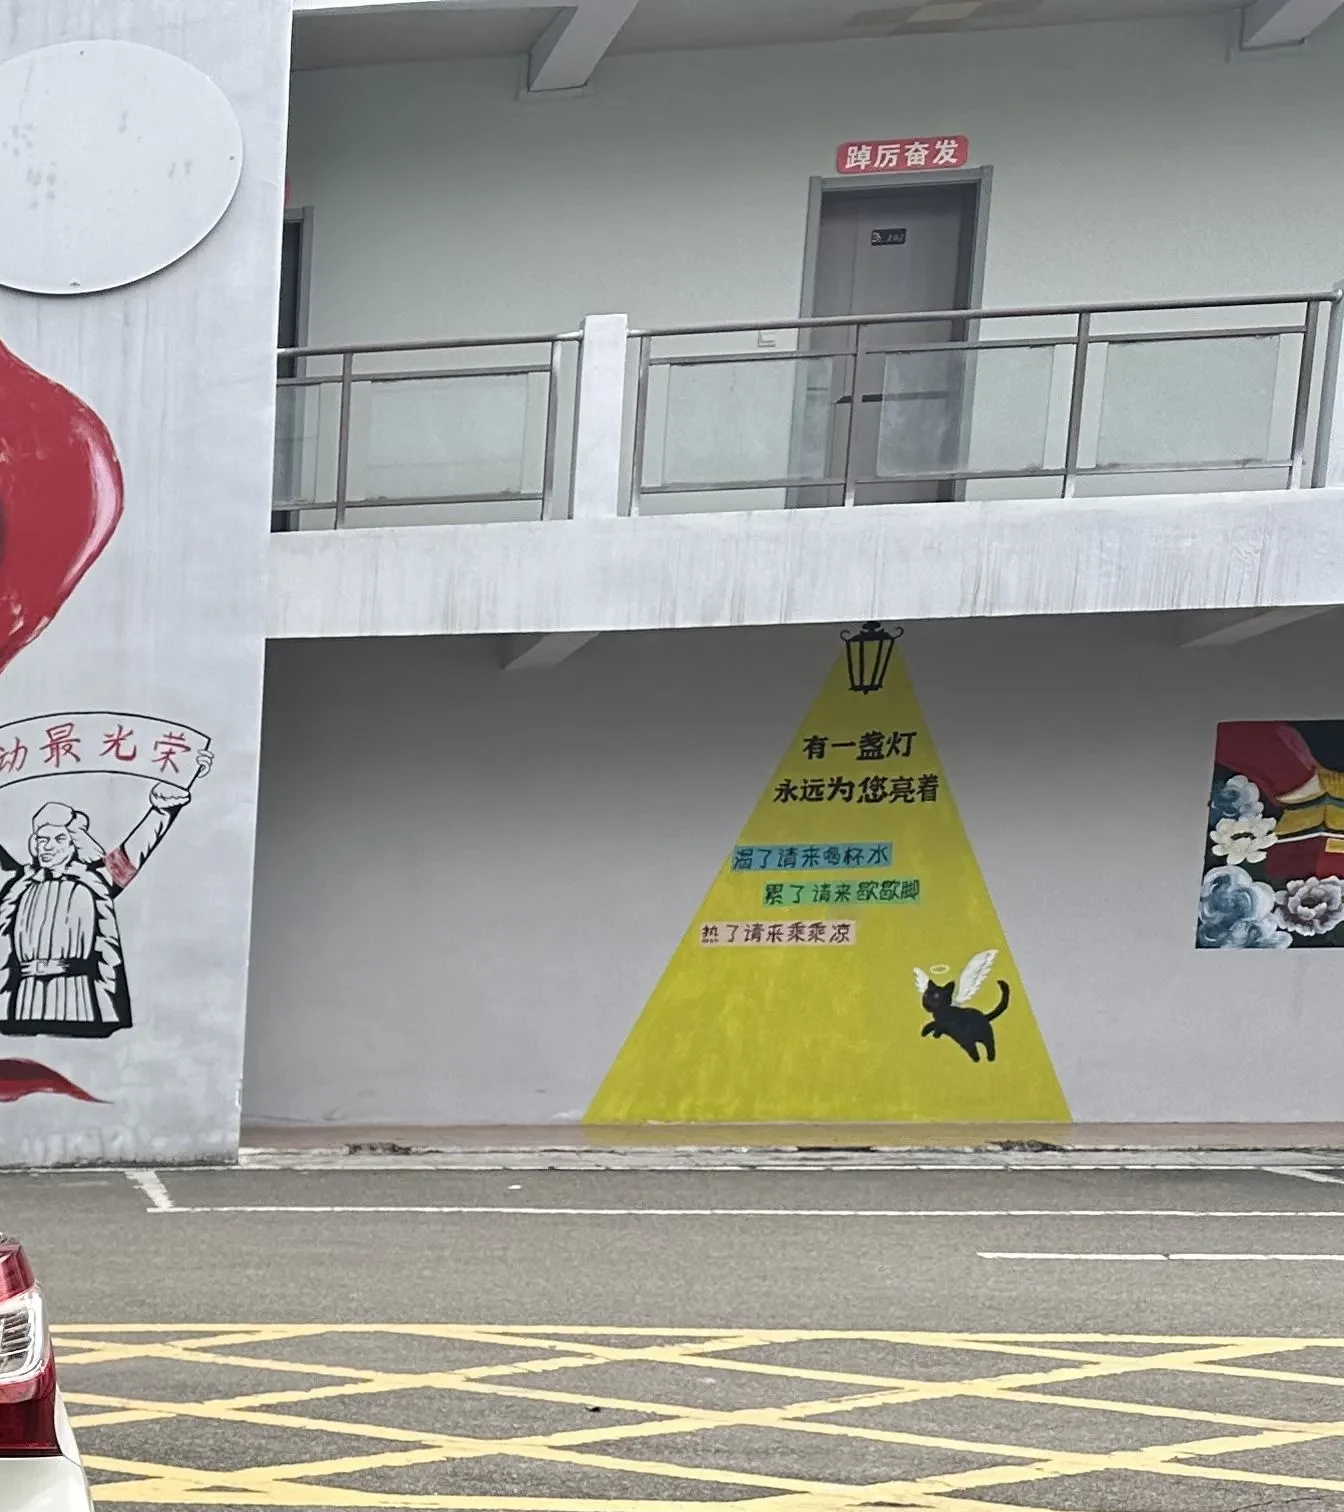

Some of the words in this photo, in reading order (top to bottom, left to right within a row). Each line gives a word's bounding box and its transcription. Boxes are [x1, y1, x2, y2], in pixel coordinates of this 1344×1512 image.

[845, 139, 959, 170] 踔厉奋发
[802, 730, 918, 761] 有一盏灯
[773, 773, 940, 804] 永远为您亮着
[701, 921, 852, 944] 热了请来乘乘凉
